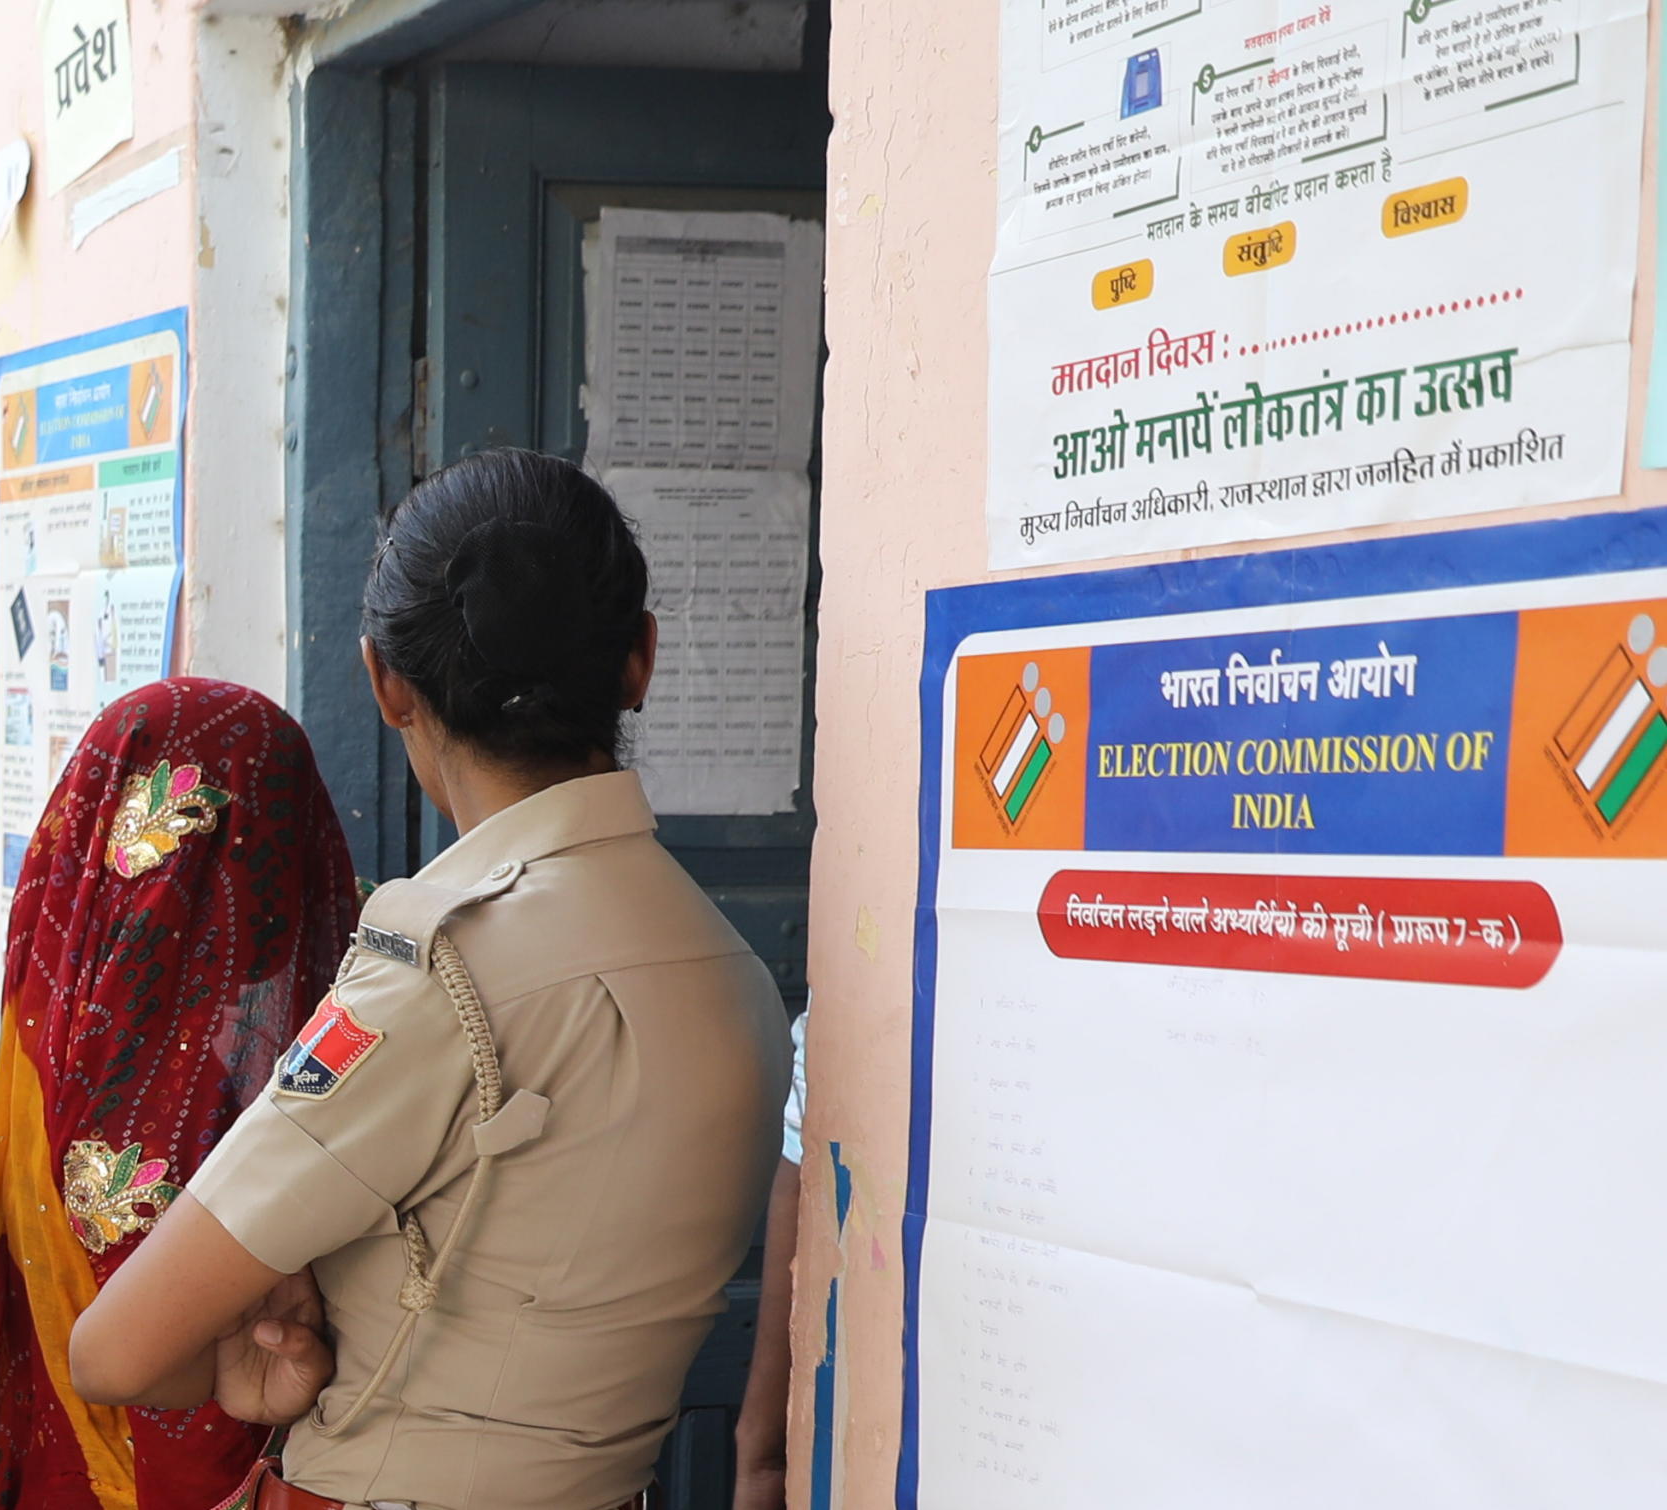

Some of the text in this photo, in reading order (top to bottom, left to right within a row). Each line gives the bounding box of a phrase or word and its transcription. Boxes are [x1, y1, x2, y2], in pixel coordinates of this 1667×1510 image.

[55, 19, 117, 119] प्रवेश
[1202, 69, 1211, 89] 5
[1146, 212, 1184, 242] मतदान
[1189, 202, 1202, 230] के
[1207, 197, 1238, 224] समय
[1294, 171, 1329, 203] प्रदान
[1334, 161, 1376, 191] करता
[1381, 148, 1393, 183] है
[1394, 193, 1457, 228] विश्वास
[1236, 230, 1283, 266] संतुष्टि
[1110, 268, 1137, 303] पुष्टि
[1051, 353, 1140, 397] मतदान
[1147, 327, 1217, 377] दिवस
[1052, 347, 1519, 480] आओ मनायें लोकतंत्र का उत्सव
[1019, 427, 1565, 546] मुख्य निर्वाचन अधिकारी, राजस्थान द्वारा जनहित में प्रकाशित
[1160, 641, 1417, 708] भारत निर्वाचन आयोग
[1098, 731, 1493, 778] ELECTION COMMISSION OF
[1231, 793, 1315, 830] INDIA
[1066, 893, 1125, 930] निर्वाचन
[1127, 896, 1168, 937] लड़ने
[1171, 897, 1209, 932] वाले
[1213, 899, 1297, 938] अभ्यर्थियों
[1301, 904, 1327, 938] की
[1332, 903, 1374, 953] सूची
[1391, 914, 1449, 946] प्रारूप
